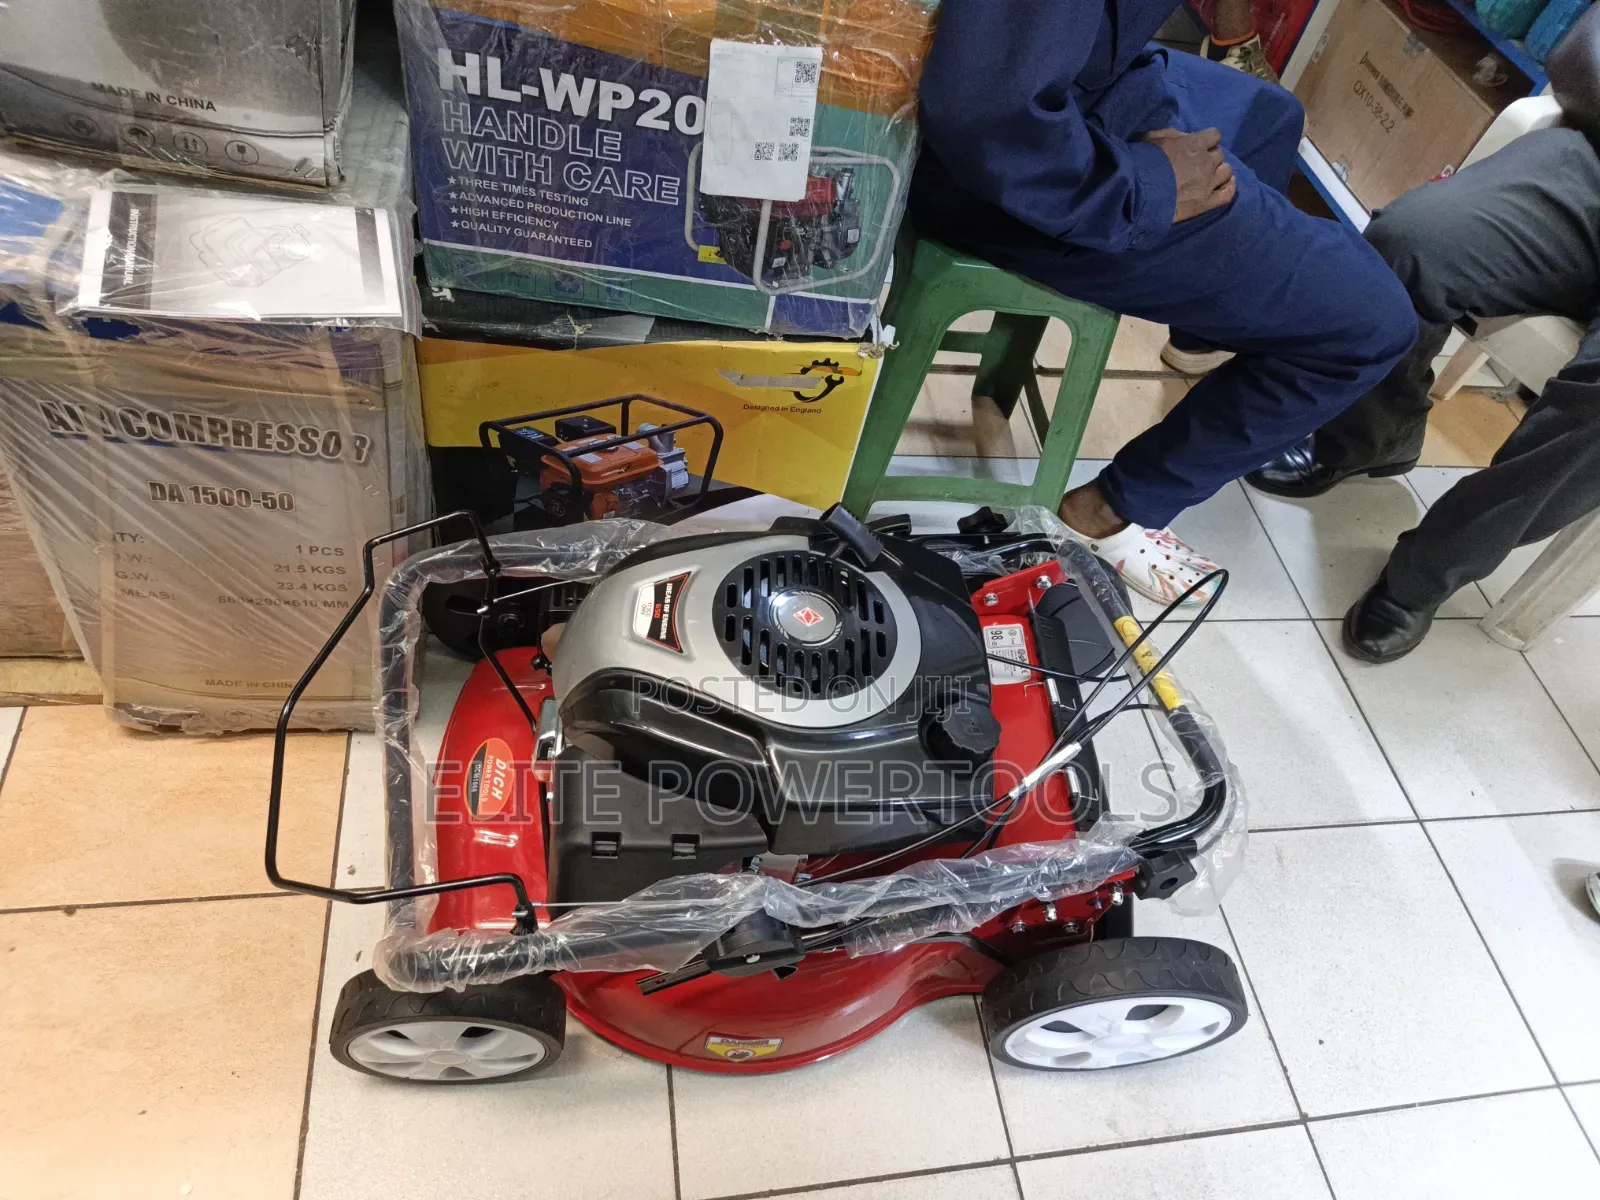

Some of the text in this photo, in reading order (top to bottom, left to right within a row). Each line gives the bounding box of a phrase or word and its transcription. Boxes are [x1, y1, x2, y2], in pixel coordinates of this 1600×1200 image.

[91, 82, 217, 112] MADE IN CHINA
[437, 48, 706, 135] HL-WP20
[441, 100, 622, 162] HANDLE
[440, 137, 680, 206] WITH CARE
[458, 175, 589, 206] THREE TIMES TESTING
[459, 192, 632, 227] ADVANCED PRODUCTION LINE
[460, 206, 559, 230] HIGH EFFICIENCY
[123, 208, 140, 285] INSTRUCTION MANUAL
[461, 220, 593, 248] QUALITY GUARANTEED
[743, 403, 780, 412] Designed
[790, 406, 822, 414] England
[117, 406, 370, 463] COMPRESSOR
[147, 481, 296, 512] DA 1500-50
[112, 531, 345, 557] TY: 1 PCS
[274, 563, 306, 574] 21.5
[311, 565, 346, 575] KGS
[276, 581, 308, 591] 23.4
[313, 583, 348, 592] KGS
[323, 600, 349, 609] MM
[660, 583, 673, 640] IDEAS OF ENGINE
[991, 630, 1003, 640] 98
[205, 679, 242, 687] MADE
[262, 681, 296, 689] CHIN
[481, 755, 494, 802] POWER TOOLS
[492, 758, 507, 800] DICH
